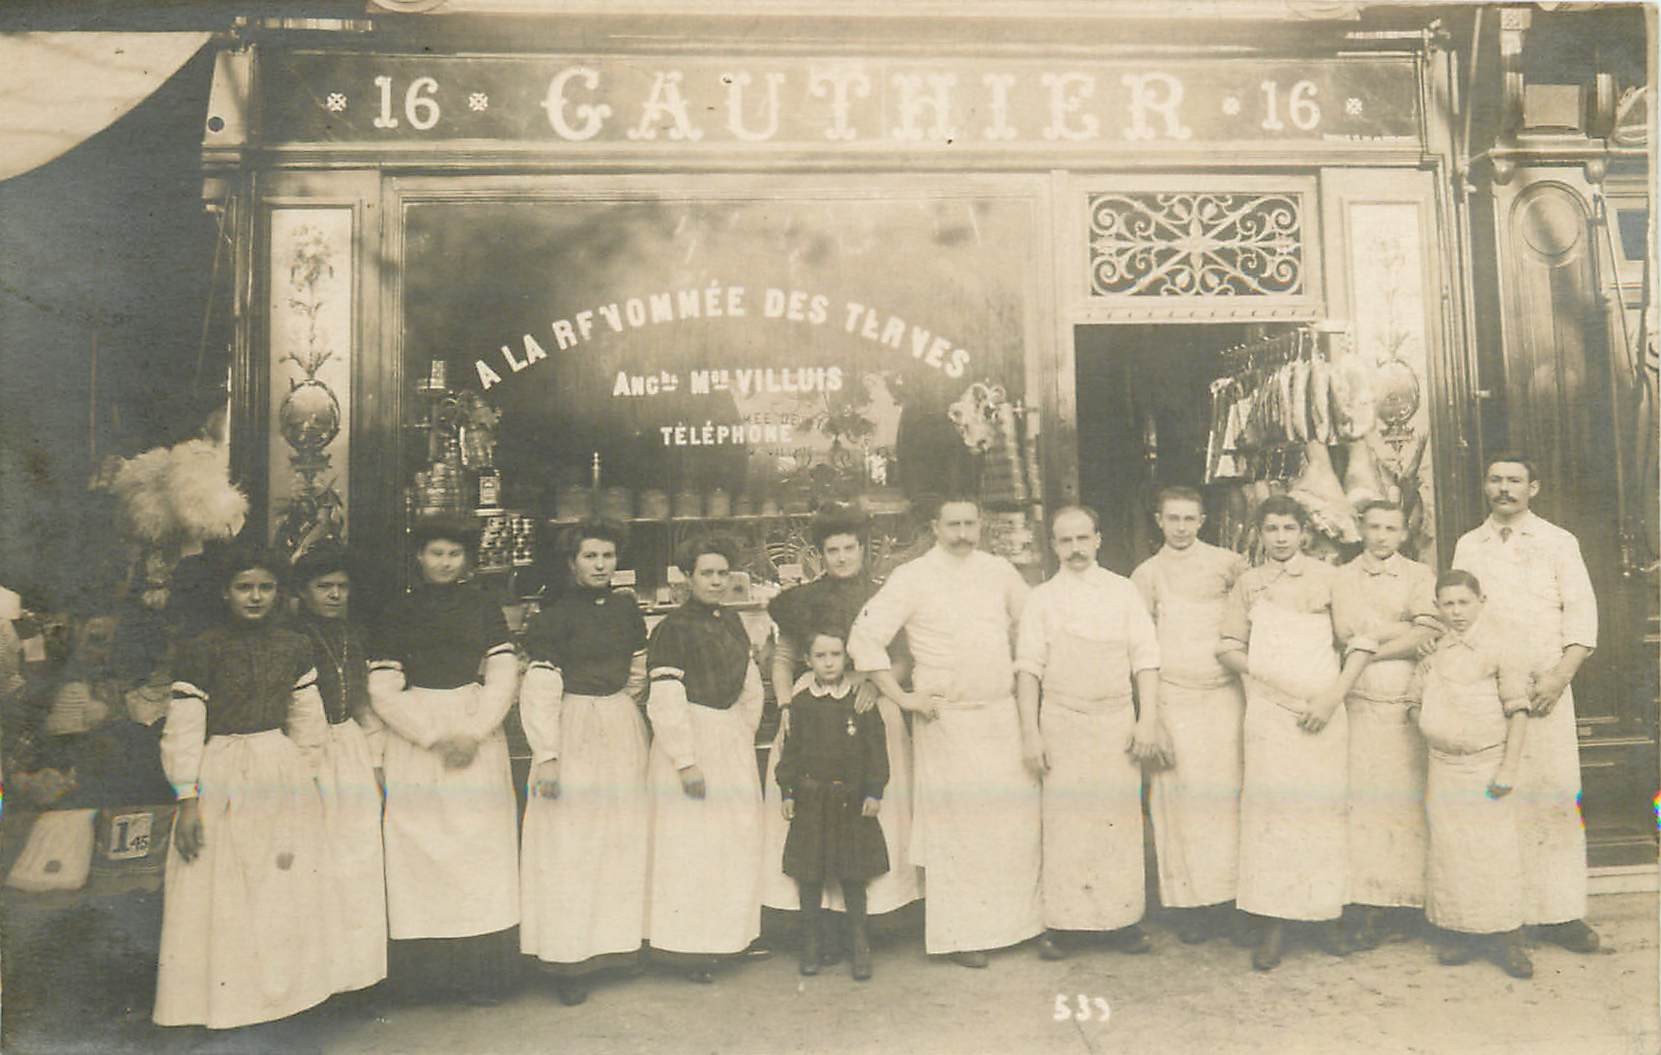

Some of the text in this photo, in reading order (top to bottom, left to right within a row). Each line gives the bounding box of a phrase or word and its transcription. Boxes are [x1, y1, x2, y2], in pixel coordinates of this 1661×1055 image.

[373, 64, 1322, 142] 16 GAUTHIER 16
[474, 359, 502, 391] A
[500, 333, 548, 373] LA
[763, 287, 830, 325] DES
[660, 419, 793, 447] TÉLÉPHONE
